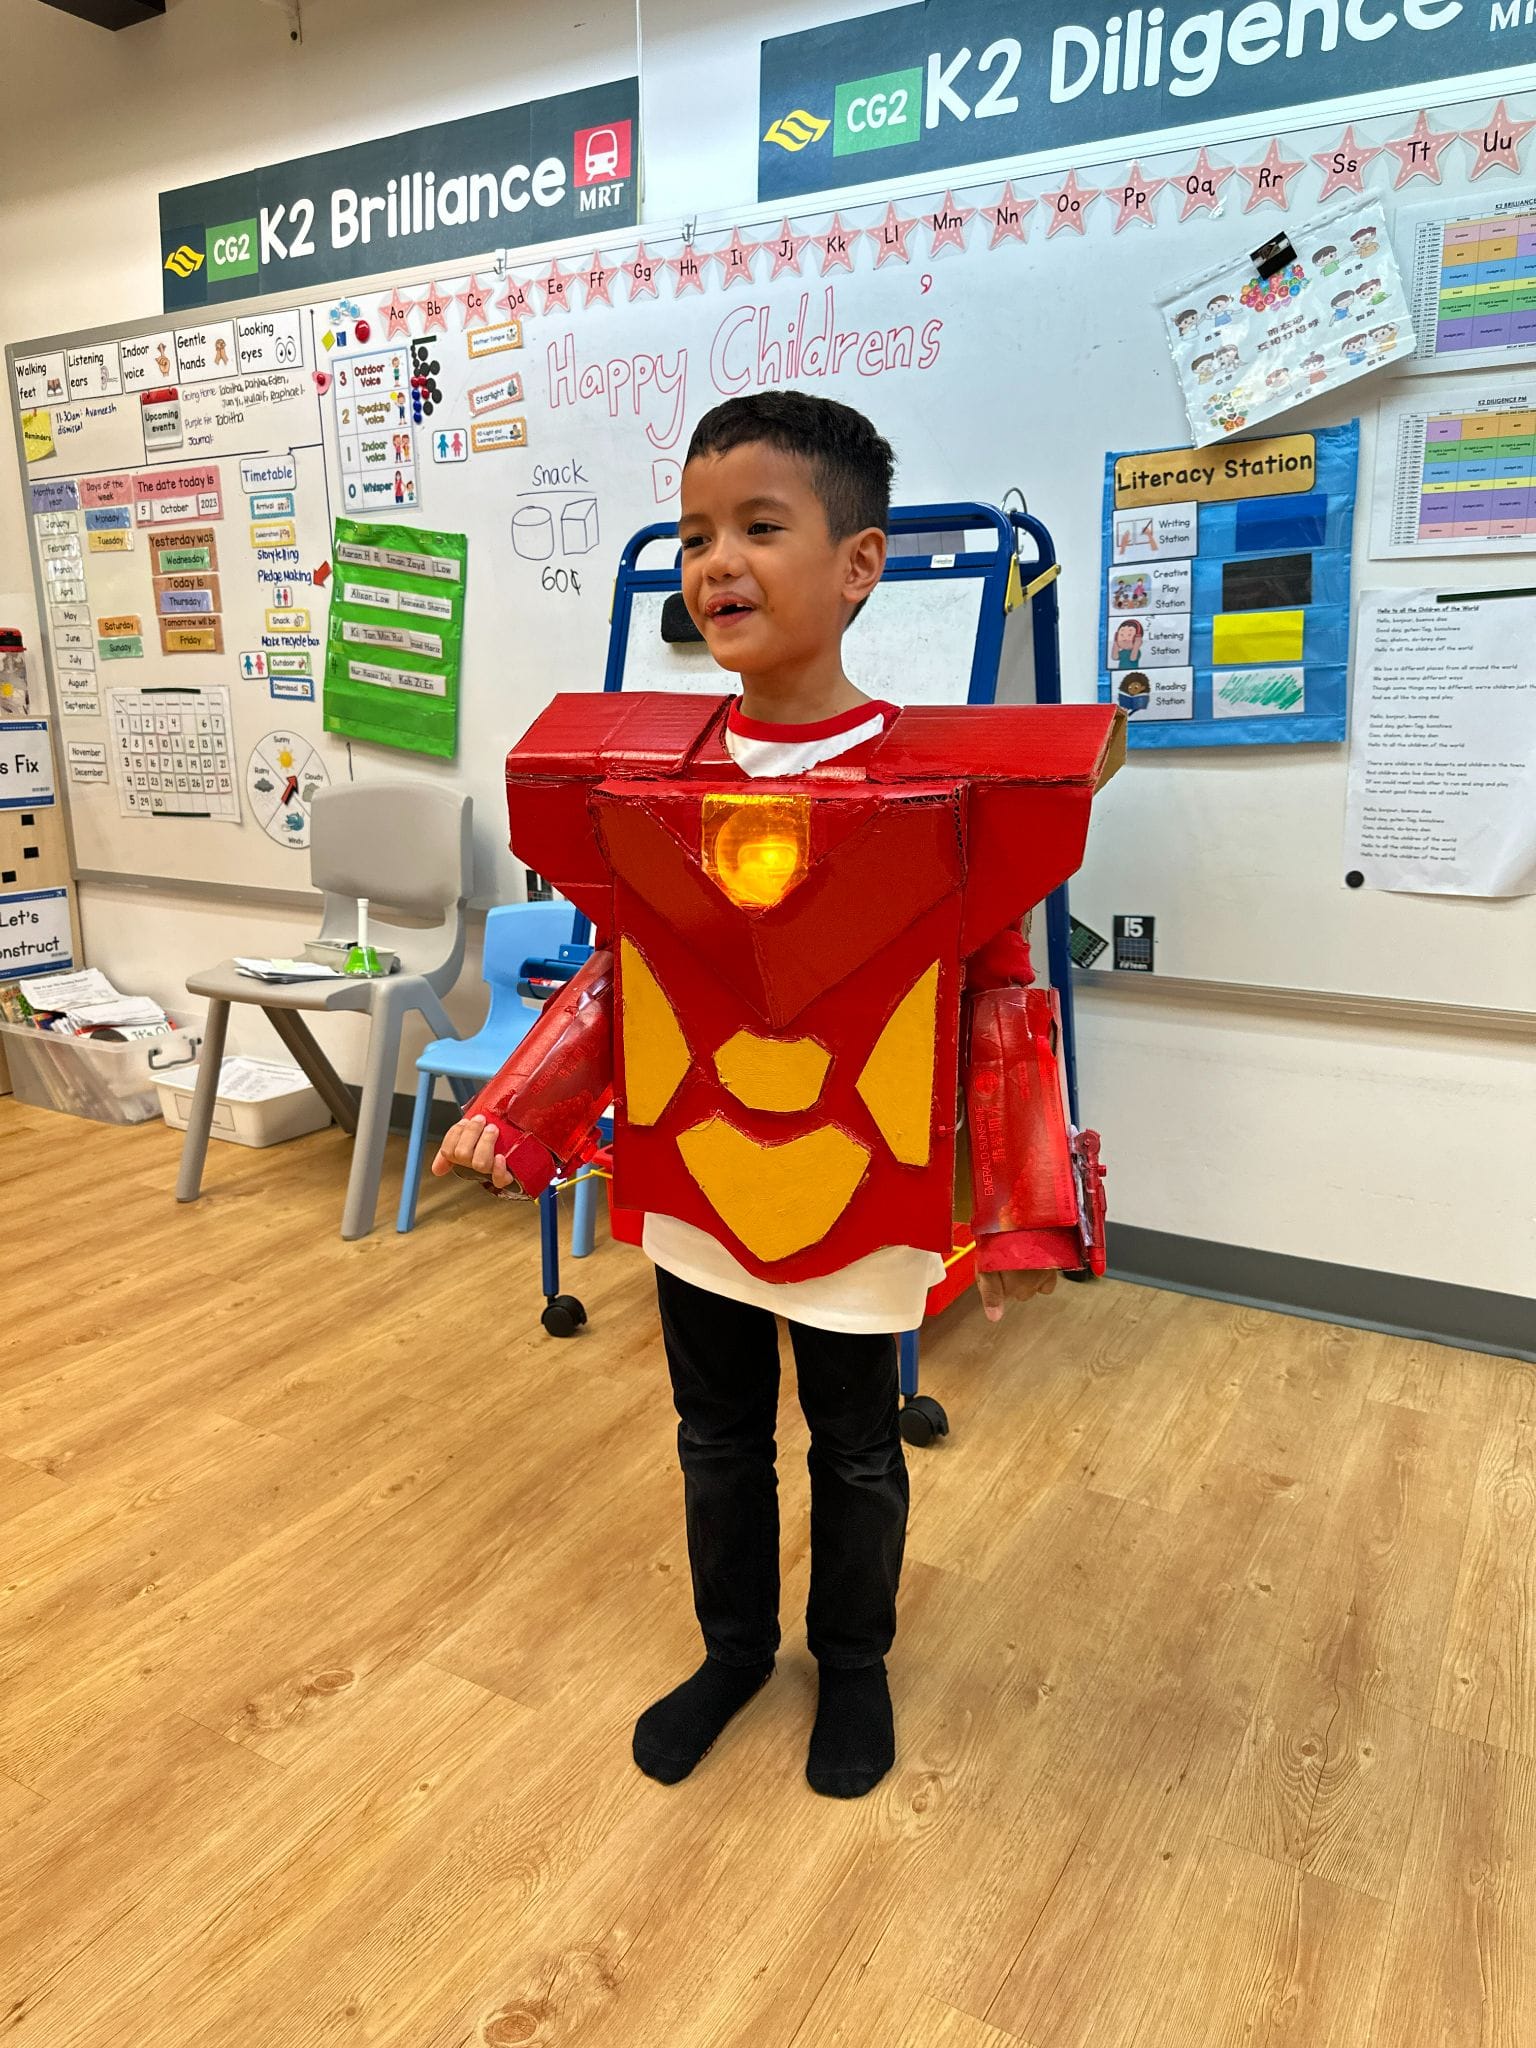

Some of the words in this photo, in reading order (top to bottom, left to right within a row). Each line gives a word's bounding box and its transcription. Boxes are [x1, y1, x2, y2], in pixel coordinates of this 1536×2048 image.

[847, 88, 908, 133] CG2
[925, 38, 1022, 129] K2
[1484, 130, 1511, 152] Uu
[1407, 141, 1431, 163] Tt
[1332, 153, 1358, 174] Ss
[1258, 168, 1283, 188] Rr
[1186, 175, 1215, 196] Qq
[579, 182, 624, 212] MRT
[1057, 194, 1080, 213] Oo
[1124, 187, 1146, 209] Pp
[213, 233, 250, 266] CG2
[260, 198, 315, 265] K2
[331, 157, 566, 249] Brilliance
[996, 207, 1019, 226] Nn
[933, 212, 963, 231] Mm
[884, 224, 899, 244] Ll
[778, 239, 794, 261] Jj
[826, 236, 846, 254] Kk
[731, 248, 743, 265] Ii
[634, 263, 651, 281] Gg
[680, 259, 698, 276] Hh
[589, 270, 605, 289] Ff
[547, 279, 563, 295] Ee
[467, 292, 482, 307] Cc
[508, 292, 524, 310] Dd
[389, 302, 404, 319] Aa
[427, 300, 441, 317] Bb
[239, 322, 274, 338] Looking
[177, 333, 206, 349] Gentle
[122, 345, 149, 358] Indoor
[241, 348, 262, 360] eyes
[68, 352, 104, 367] Listening
[180, 357, 206, 371] hands
[16, 362, 47, 377] Walking
[125, 368, 145, 380] voice
[339, 371, 347, 386] 3
[354, 363, 385, 376] Outdoor
[70, 377, 88, 388] ears
[360, 376, 381, 387] Voice
[19, 388, 36, 399] feet
[475, 388, 505, 406] Starlight
[547, 333, 688, 449] Happy
[145, 408, 179, 422] Upcoming
[342, 409, 350, 425] 2
[357, 401, 391, 416] Speaking
[365, 413, 385, 426] voice
[152, 421, 176, 433] events
[24, 430, 52, 442] Reminders
[361, 440, 387, 452] Indoor
[366, 452, 386, 464] voice
[242, 466, 293, 483] Timetable
[532, 459, 588, 487] Snack
[1116, 466, 1215, 492] Literacy
[1224, 454, 1313, 479] Station
[86, 482, 102, 492] Days
[103, 480, 110, 489] of
[111, 479, 124, 489] the
[137, 480, 153, 492] The
[156, 477, 176, 491] date
[179, 475, 205, 490] today
[348, 484, 356, 498] 0
[363, 480, 393, 494] Whisper
[98, 492, 114, 501] week
[141, 506, 147, 515] 5
[160, 503, 190, 514] October
[200, 498, 217, 509] 2023
[94, 514, 120, 524] Monday
[1158, 518, 1191, 530] Writing
[97, 536, 124, 546] Tuesday
[150, 534, 195, 548] Yesterday
[197, 533, 214, 544] was
[1159, 533, 1190, 544] Station
[166, 553, 205, 565] Wednesday
[257, 548, 299, 564] Storytelling
[385, 553, 406, 567] Iman
[406, 557, 426, 571] Zayd
[436, 562, 452, 575] Low
[257, 570, 283, 586] Pledge
[541, 566, 582, 596] 60¢
[1153, 568, 1189, 580] Creative
[168, 577, 195, 590] Today
[1161, 583, 1180, 595] Play
[168, 596, 201, 608] Thursday
[350, 588, 373, 601] Alison
[374, 591, 390, 604] Low
[1155, 598, 1186, 609] Station
[63, 611, 77, 621] May
[163, 618, 196, 627] Tomorrow
[198, 618, 207, 626] will
[207, 618, 217, 626] be
[272, 616, 291, 625] Snack
[104, 620, 134, 631] Saturday
[65, 633, 80, 643] June
[180, 635, 202, 646] Friday
[362, 628, 377, 640] Tan
[1148, 631, 1184, 643] Listening
[109, 643, 132, 653] Sunday
[281, 634, 306, 649] recycle
[1150, 645, 1181, 656] Station
[69, 654, 82, 665] July
[272, 658, 296, 668] Outdoor
[68, 679, 89, 689] August
[398, 674, 413, 687] Koh
[1155, 682, 1187, 693] Reading
[64, 700, 97, 711] September
[1155, 696, 1185, 707] Station
[145, 719, 151, 728] 2
[121, 737, 128, 749] 2
[273, 735, 291, 745] Sunny
[71, 747, 102, 757] November
[15, 754, 39, 774] Fix
[74, 767, 104, 777] December
[137, 777, 146, 786] 22
[150, 776, 159, 786] 23
[164, 779, 174, 788] 24
[129, 794, 136, 806] 5
[1124, 917, 1144, 938] 15
[1119, 960, 1148, 970] fifteen
